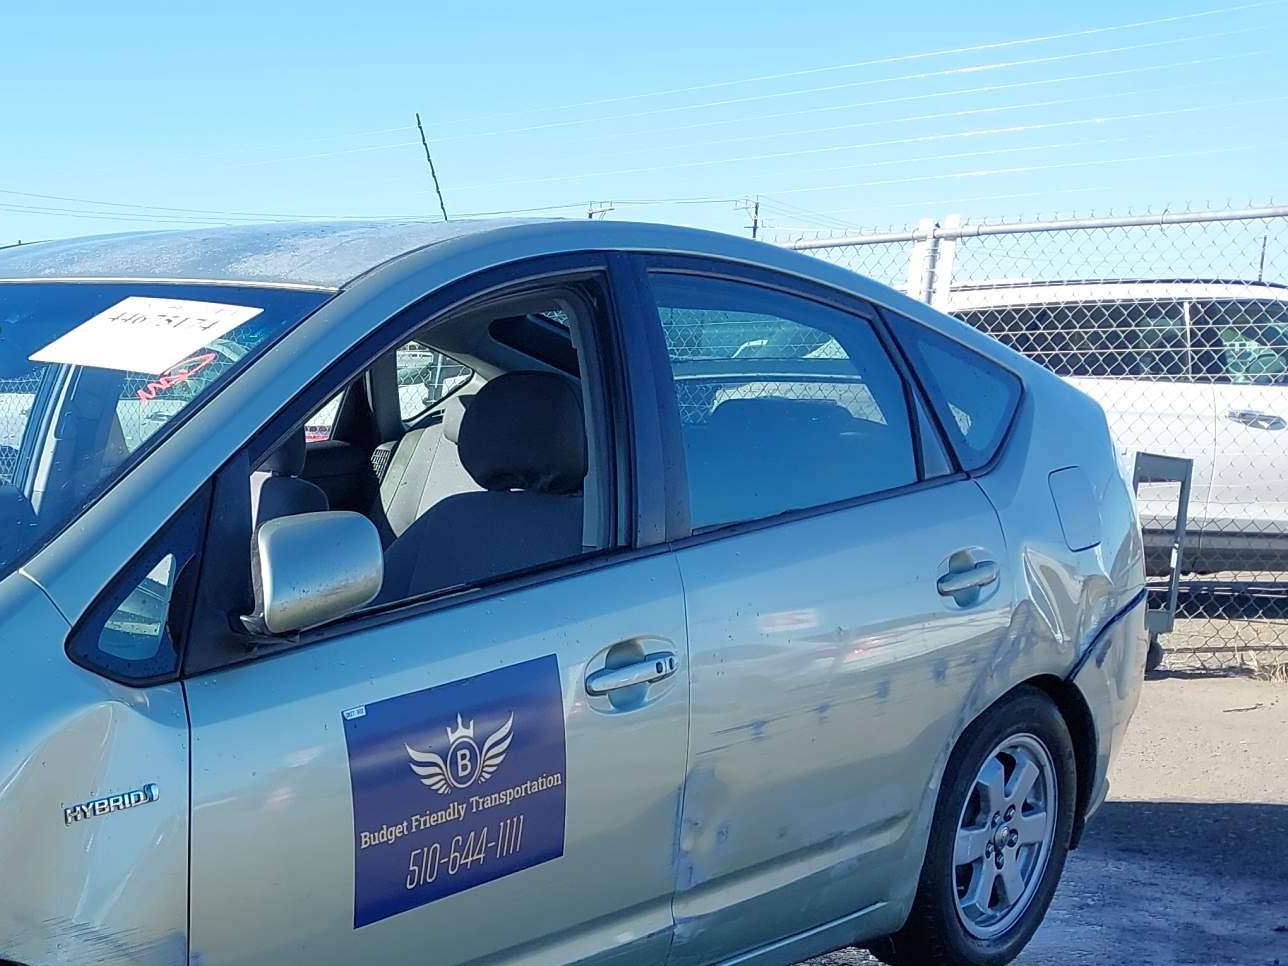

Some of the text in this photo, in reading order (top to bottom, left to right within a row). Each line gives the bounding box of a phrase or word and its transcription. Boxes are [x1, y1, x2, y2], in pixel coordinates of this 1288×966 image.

[456, 748, 472, 777] B
[64, 789, 149, 826] HYBRID
[360, 772, 562, 849] Budget Friendly Transportation
[406, 815, 524, 889] 510-644-1111
